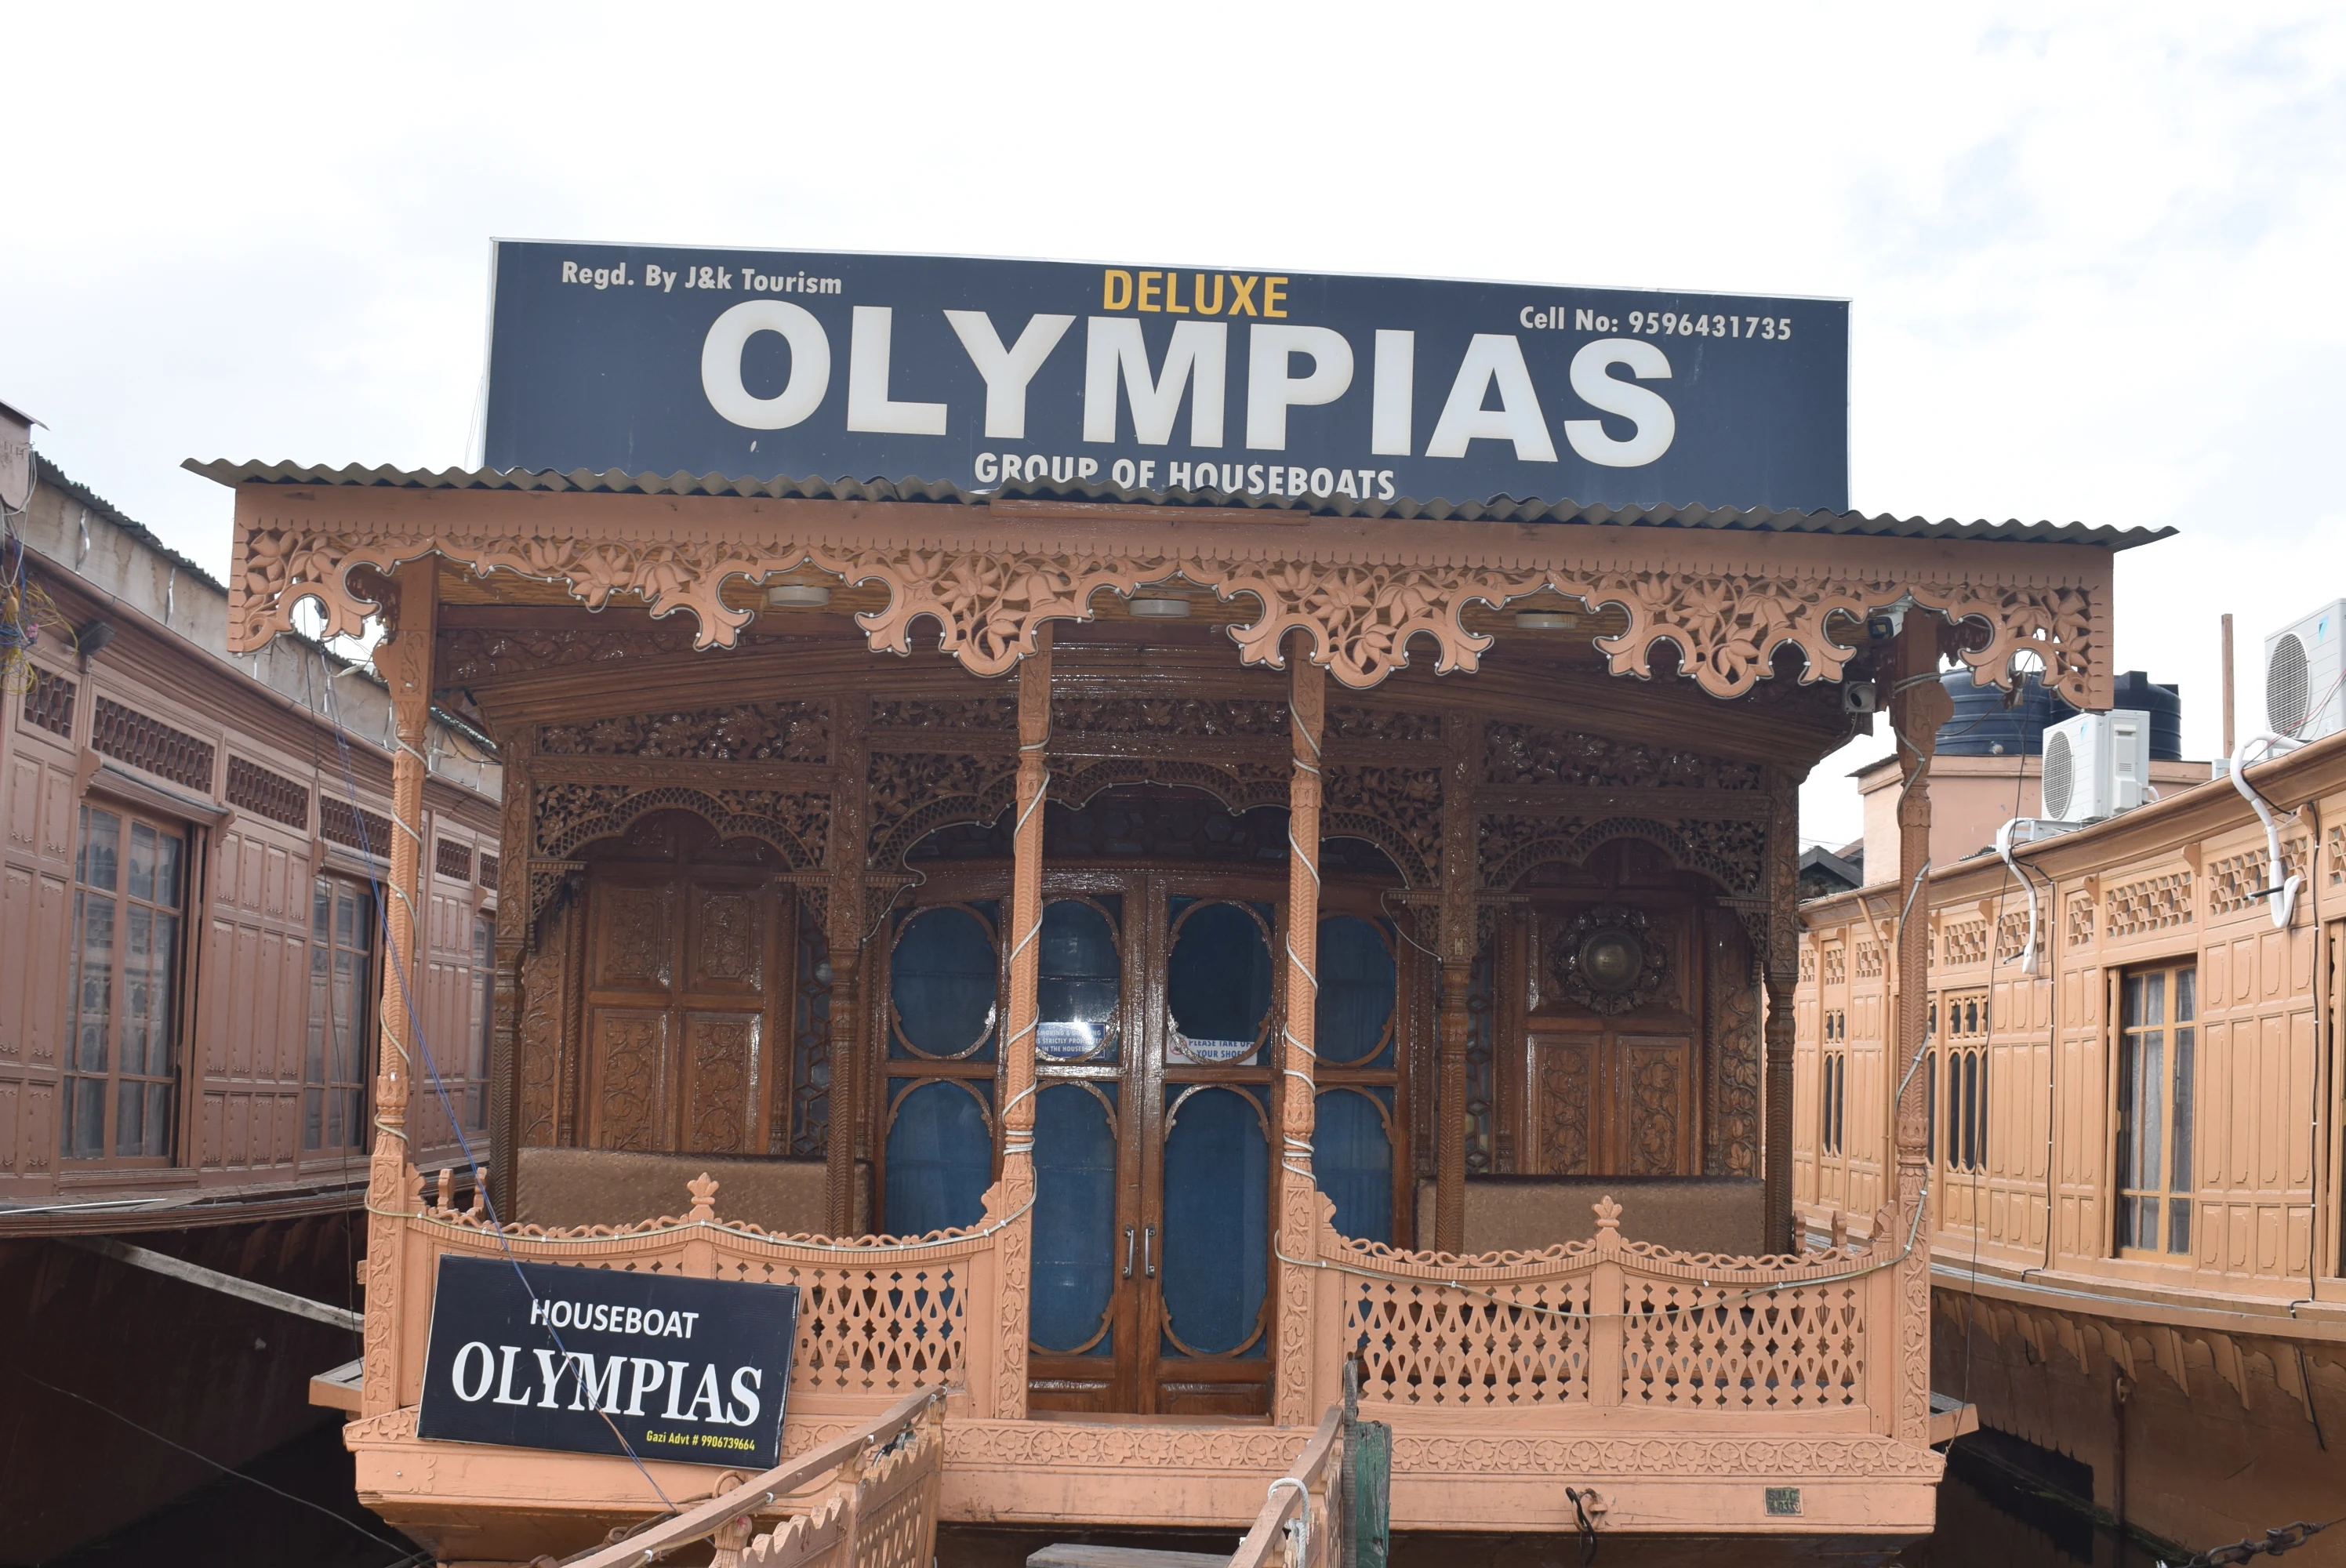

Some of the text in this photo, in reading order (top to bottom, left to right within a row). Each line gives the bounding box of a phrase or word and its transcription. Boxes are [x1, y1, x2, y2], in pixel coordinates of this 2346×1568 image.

[562, 261, 842, 294] Regd. By J&k Tourism
[1103, 270, 1288, 318] DELUXE
[1520, 306, 1791, 340] Cell No: 9596431735
[701, 299, 1676, 467] OLYMPIAS
[975, 452, 1395, 501] GROUP OF HOUSEBOATS
[1197, 1049, 1218, 1058] YOUR
[530, 1298, 699, 1339] HOUSEBOAT
[452, 1341, 762, 1427] OLYMPIAS
[646, 1430, 755, 1450] Gazi Advt # 9906739664
